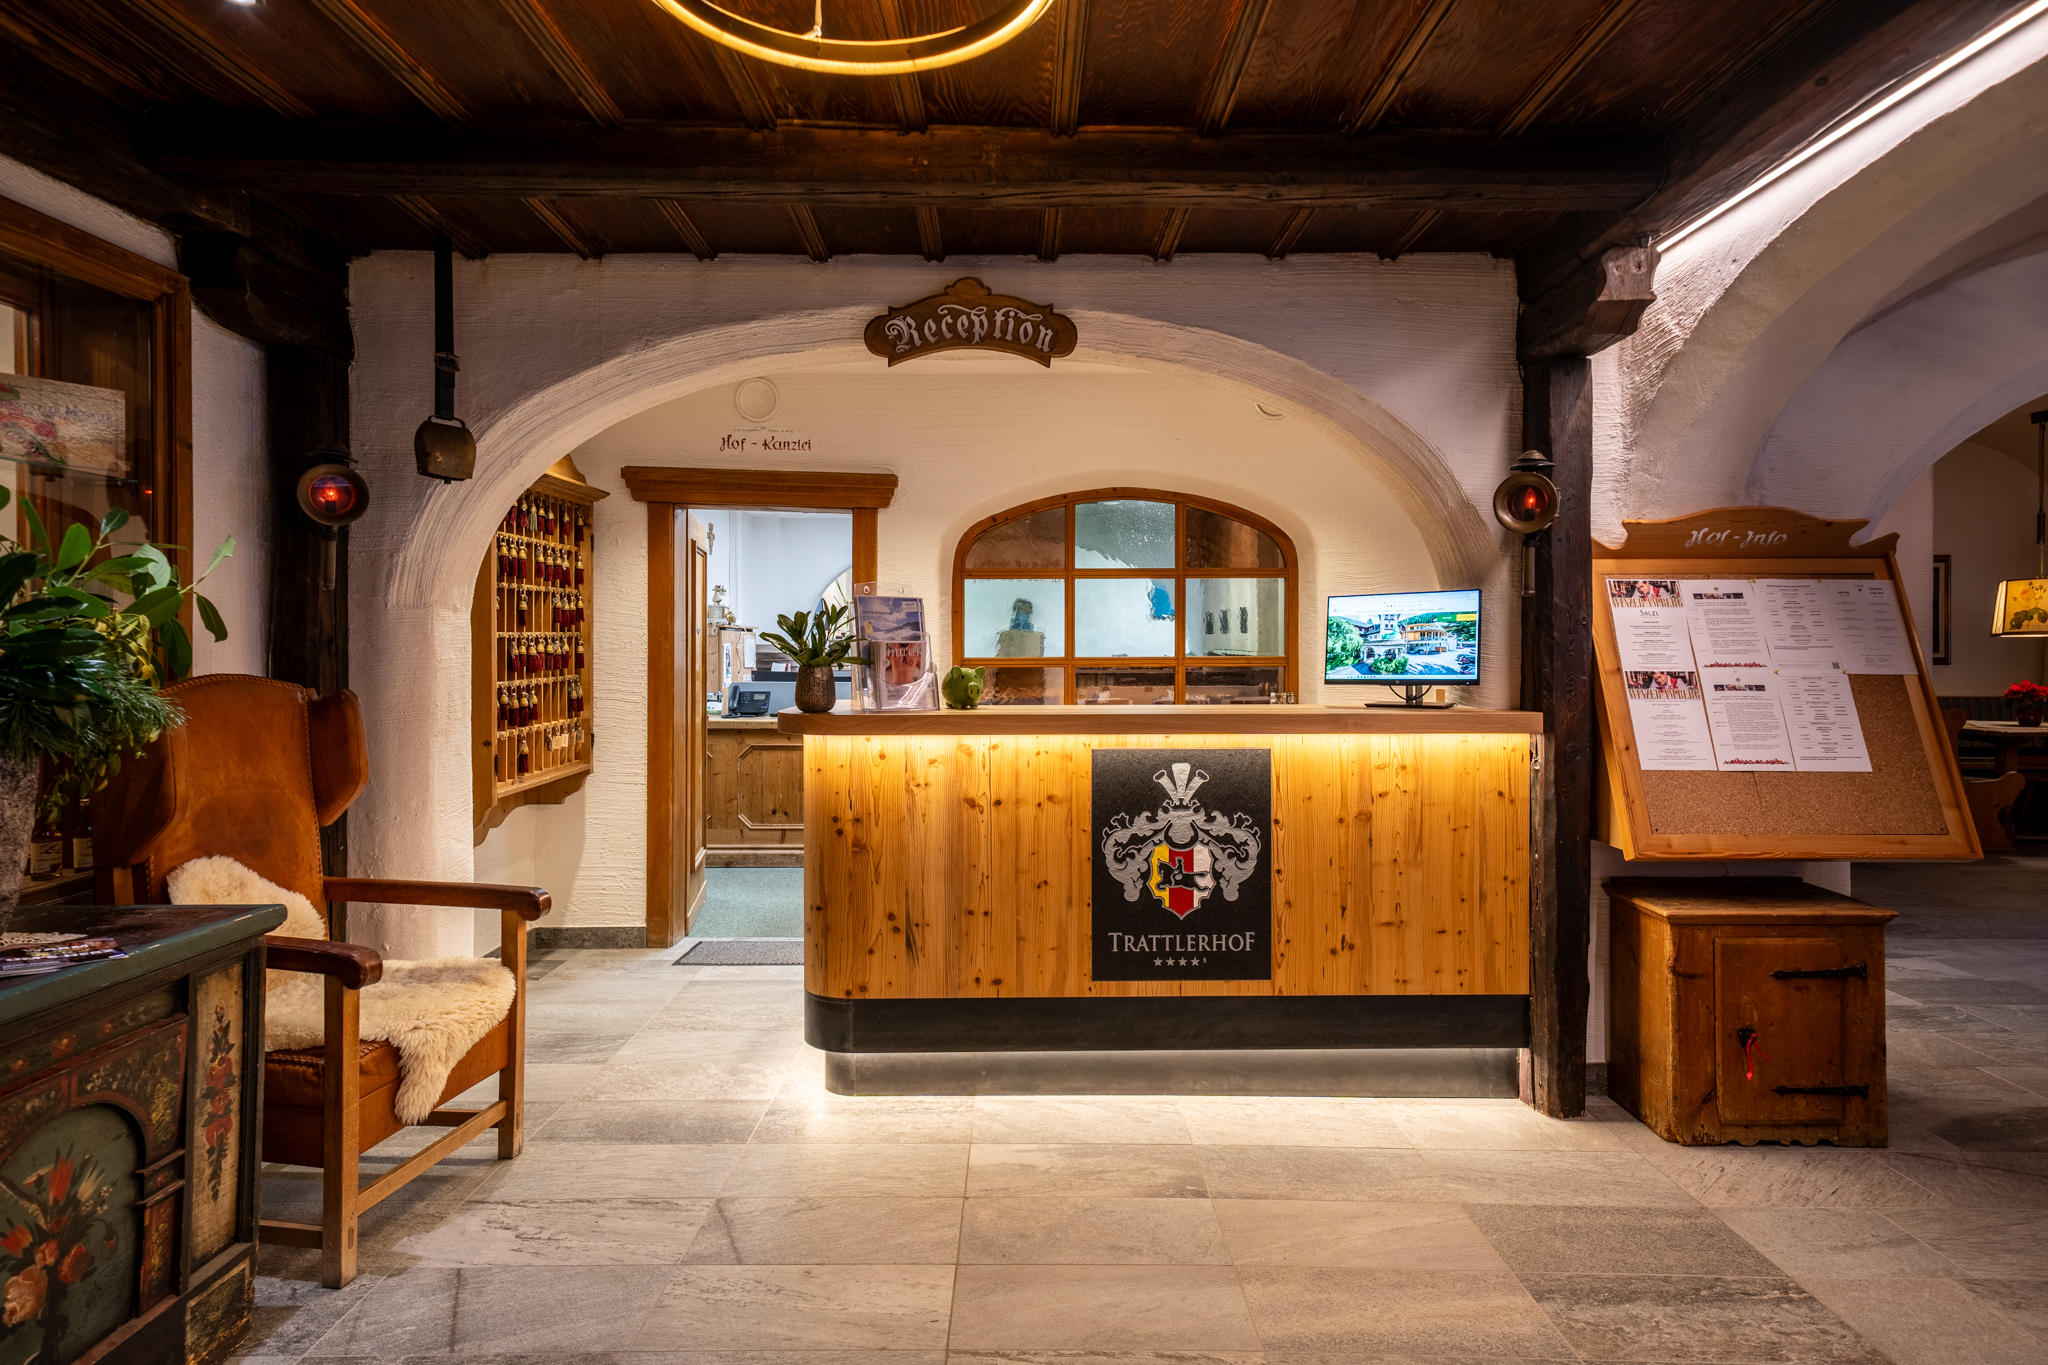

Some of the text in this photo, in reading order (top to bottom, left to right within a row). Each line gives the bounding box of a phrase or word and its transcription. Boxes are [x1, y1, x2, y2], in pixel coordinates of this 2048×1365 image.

[885, 304, 1054, 353] Reception
[720, 434, 746, 453] Hof
[762, 436, 812, 451] Kanzlei
[1107, 931, 1256, 952] TRATTLERHOF
